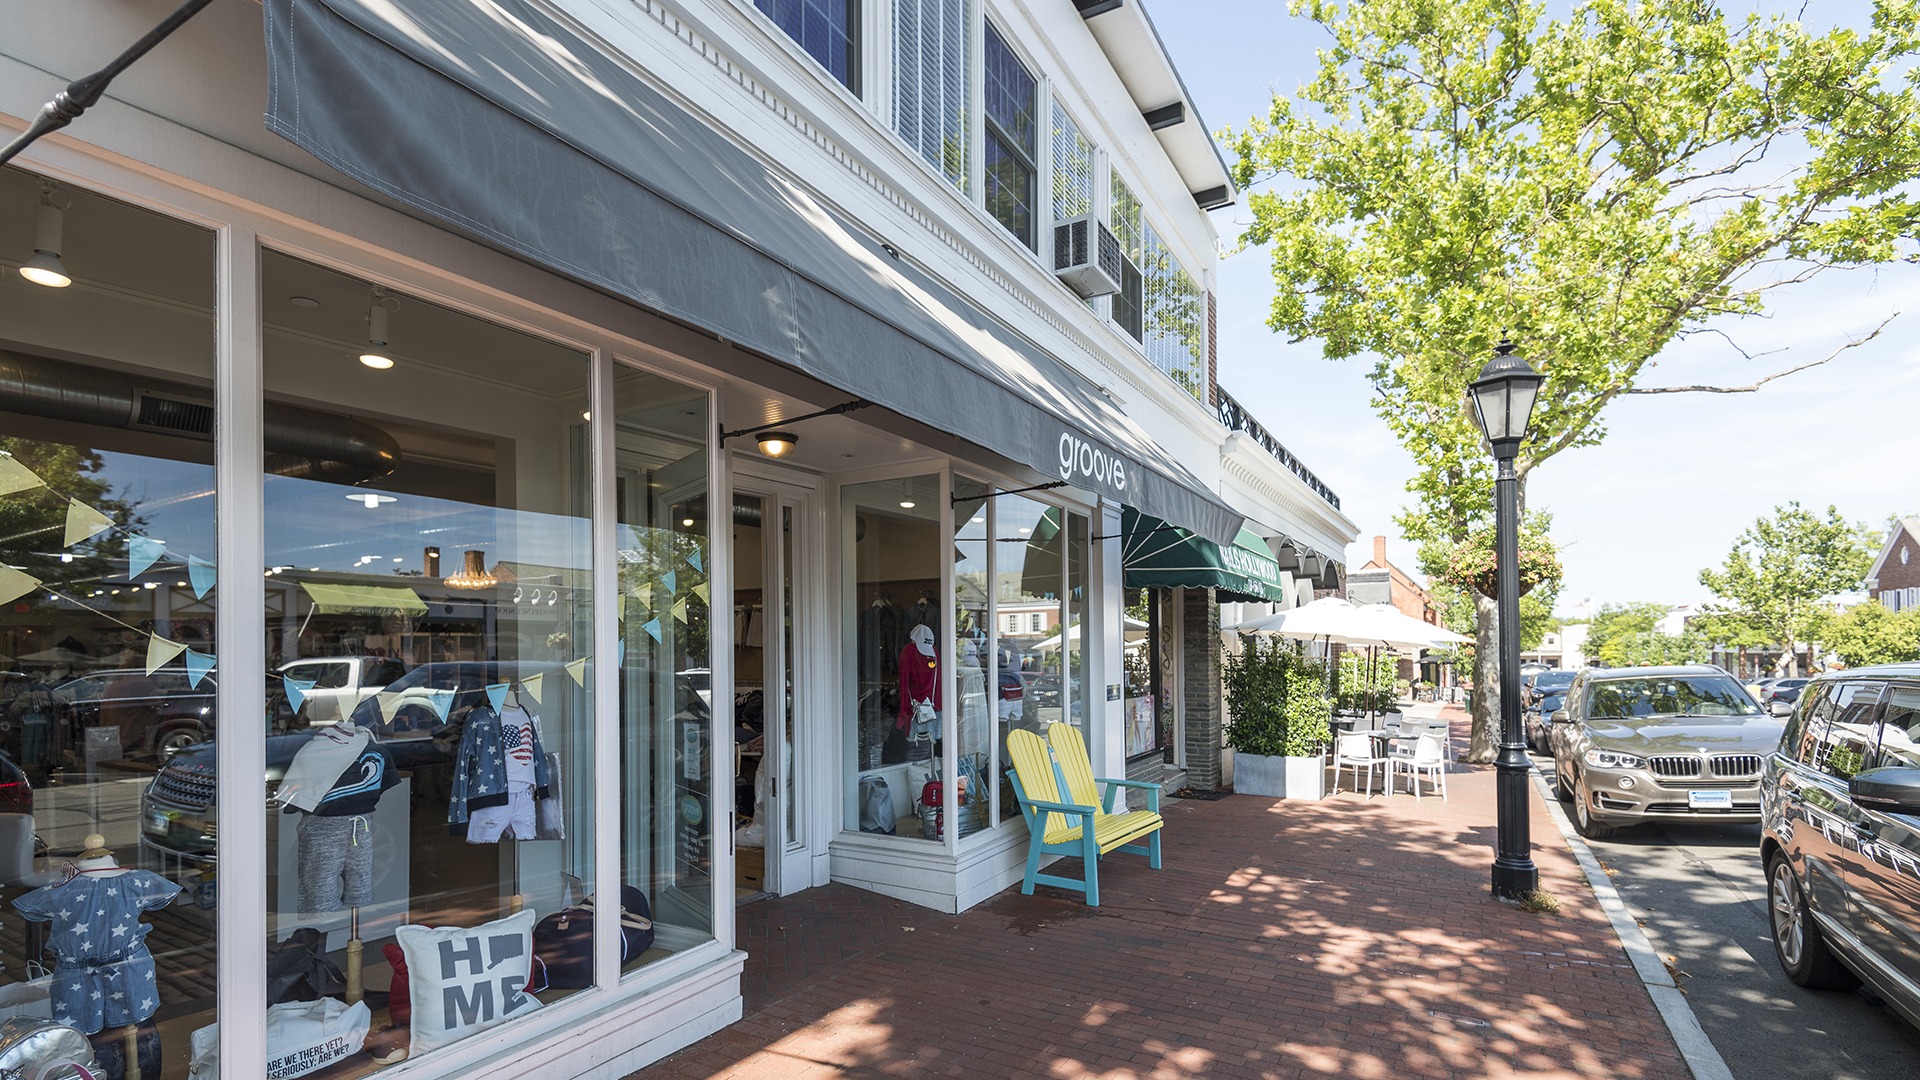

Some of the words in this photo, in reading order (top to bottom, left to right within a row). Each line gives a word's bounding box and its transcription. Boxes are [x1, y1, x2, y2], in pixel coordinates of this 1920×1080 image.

[1059, 432, 1125, 490] groove
[1240, 550, 1277, 582] HOLLYWOOD
[682, 802, 700, 816] groove
[443, 976, 528, 1030] ME
[267, 1058, 283, 1073] ARE
[284, 1053, 297, 1066] WE
[298, 1044, 325, 1060] THERE
[325, 1036, 344, 1052] YET?
[318, 1053, 334, 1065] ARE
[334, 1043, 350, 1057] WE?
